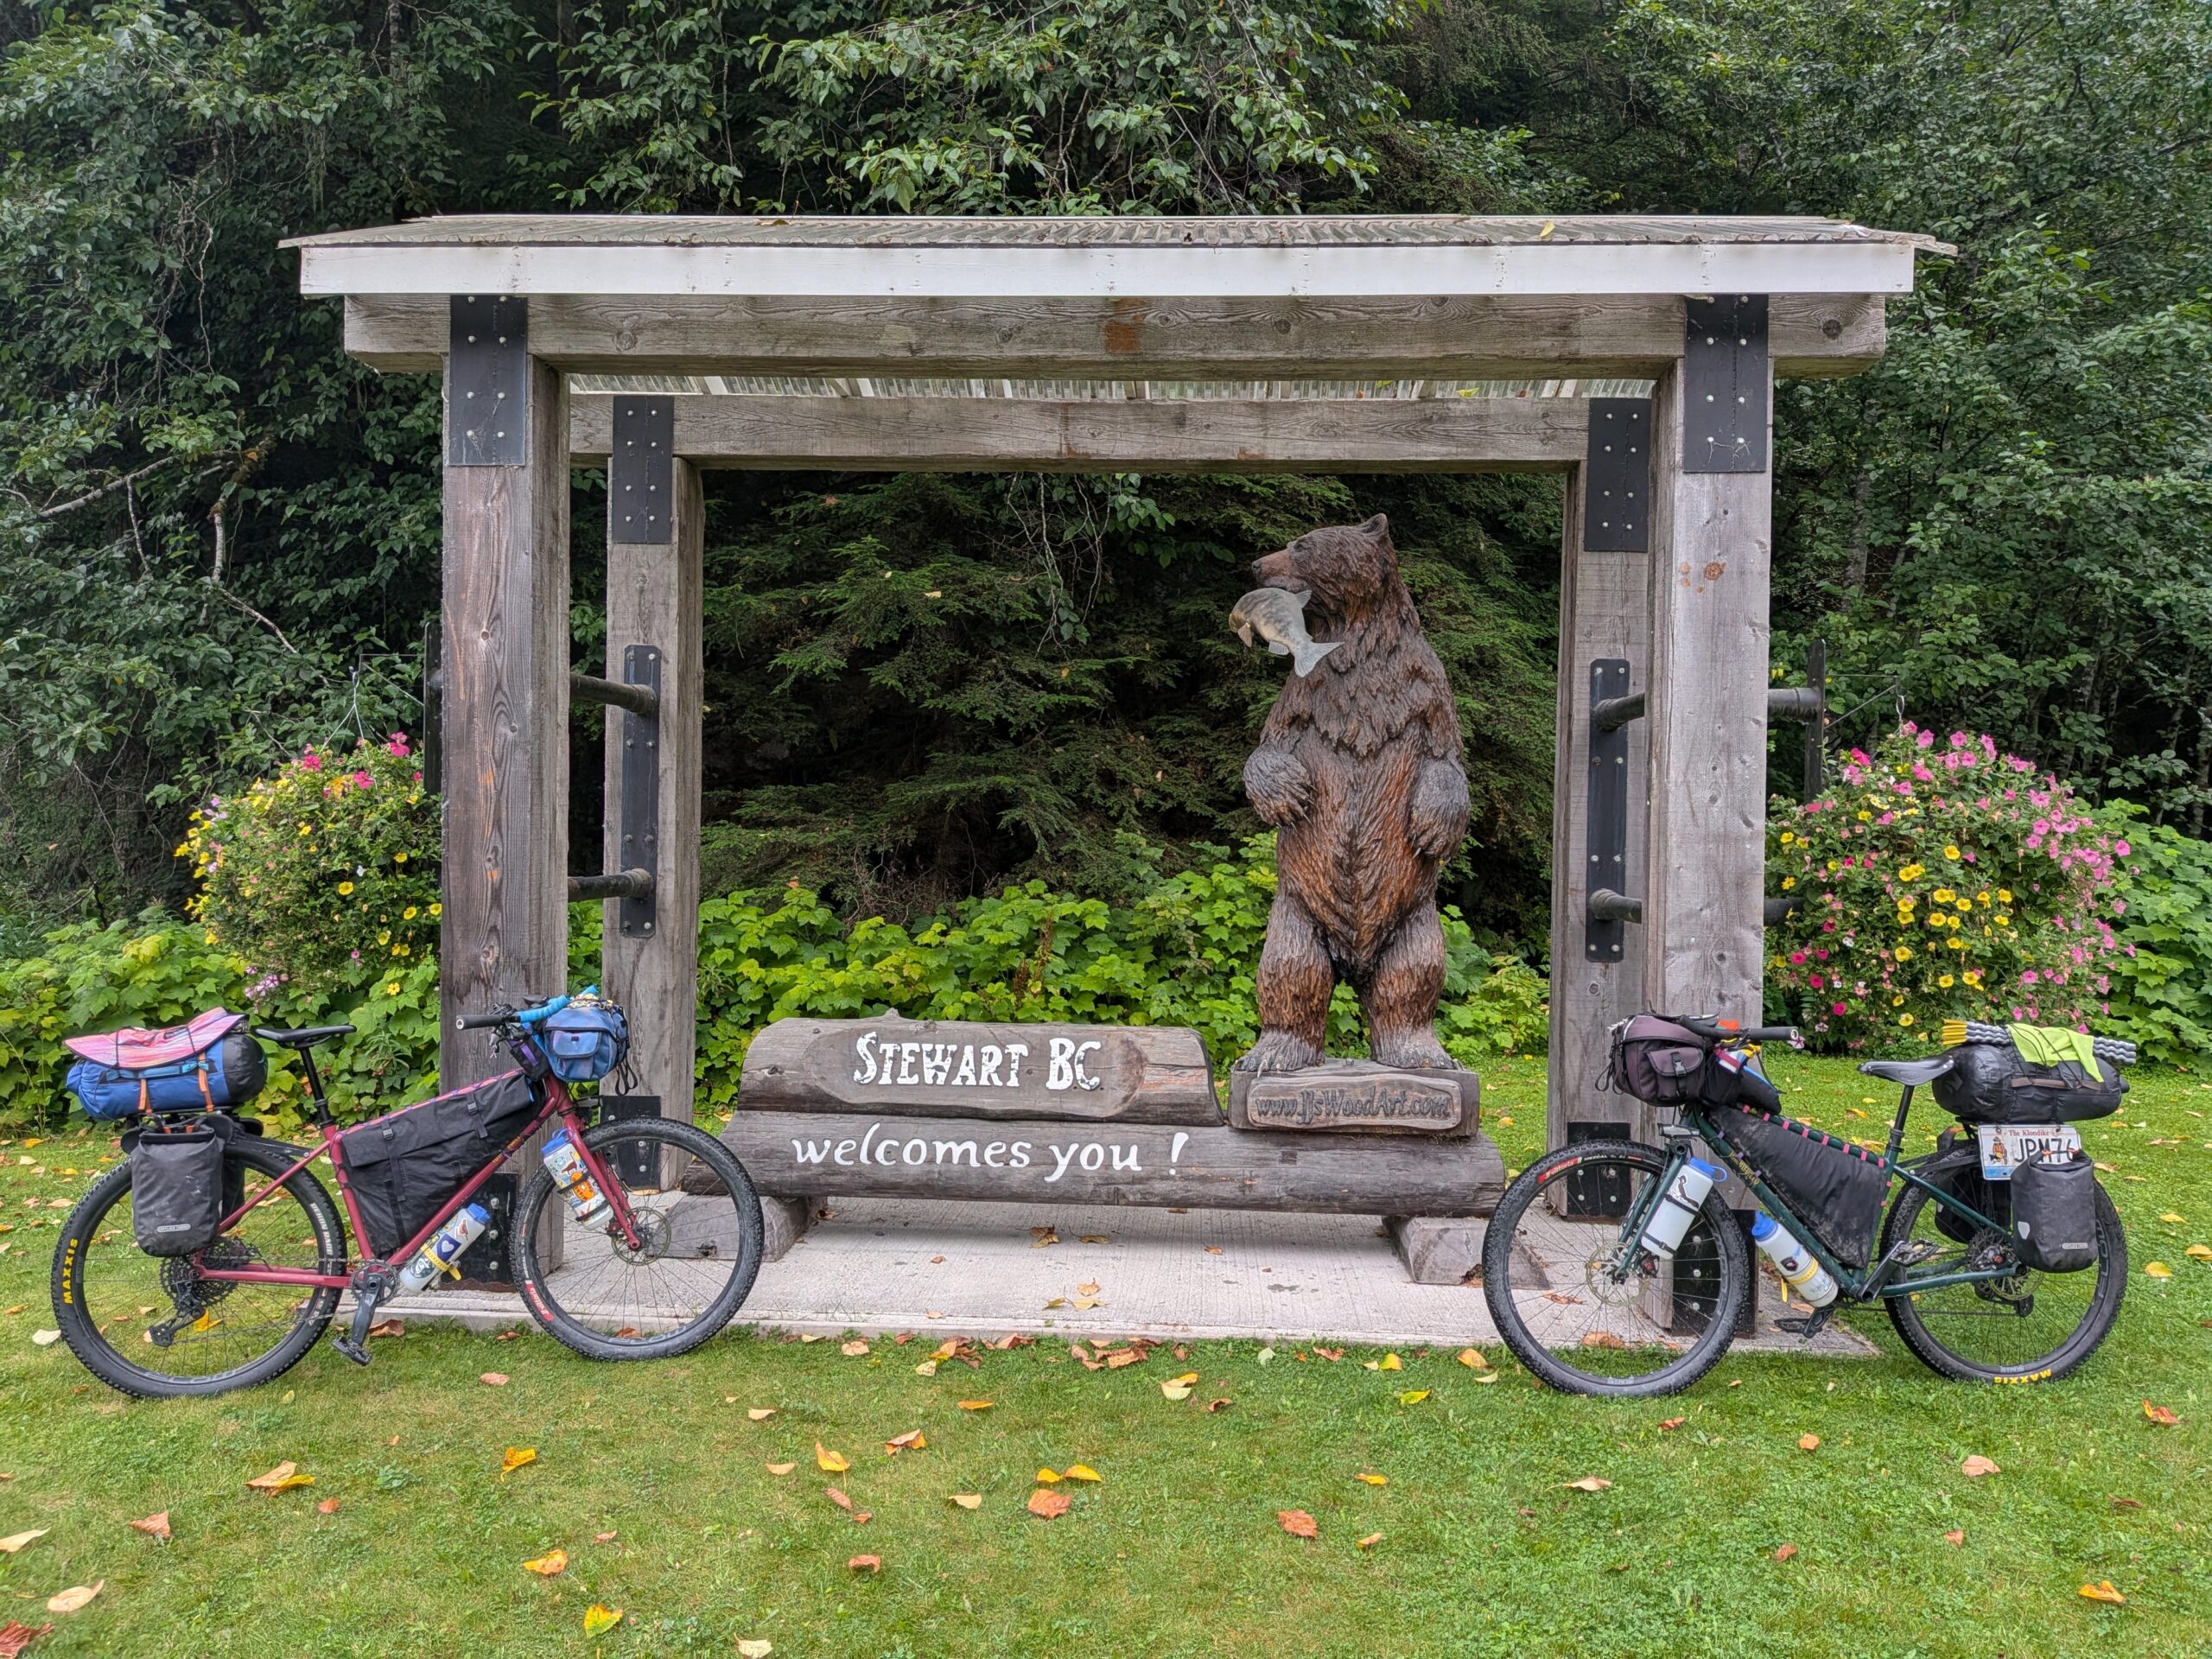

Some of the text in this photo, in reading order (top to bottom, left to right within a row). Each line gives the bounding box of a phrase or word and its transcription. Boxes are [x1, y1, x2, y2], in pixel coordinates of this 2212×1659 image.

[853, 1031, 1029, 1087] STEWART
[1255, 1085, 1452, 1125] www.JJsWoodArt.com
[791, 1121, 1190, 1182] welcomes you !
[2022, 1128, 2050, 1137] Klondike
[61, 1238, 79, 1305] MAXXIS
[1993, 1368, 2052, 1384] MAXXIS
